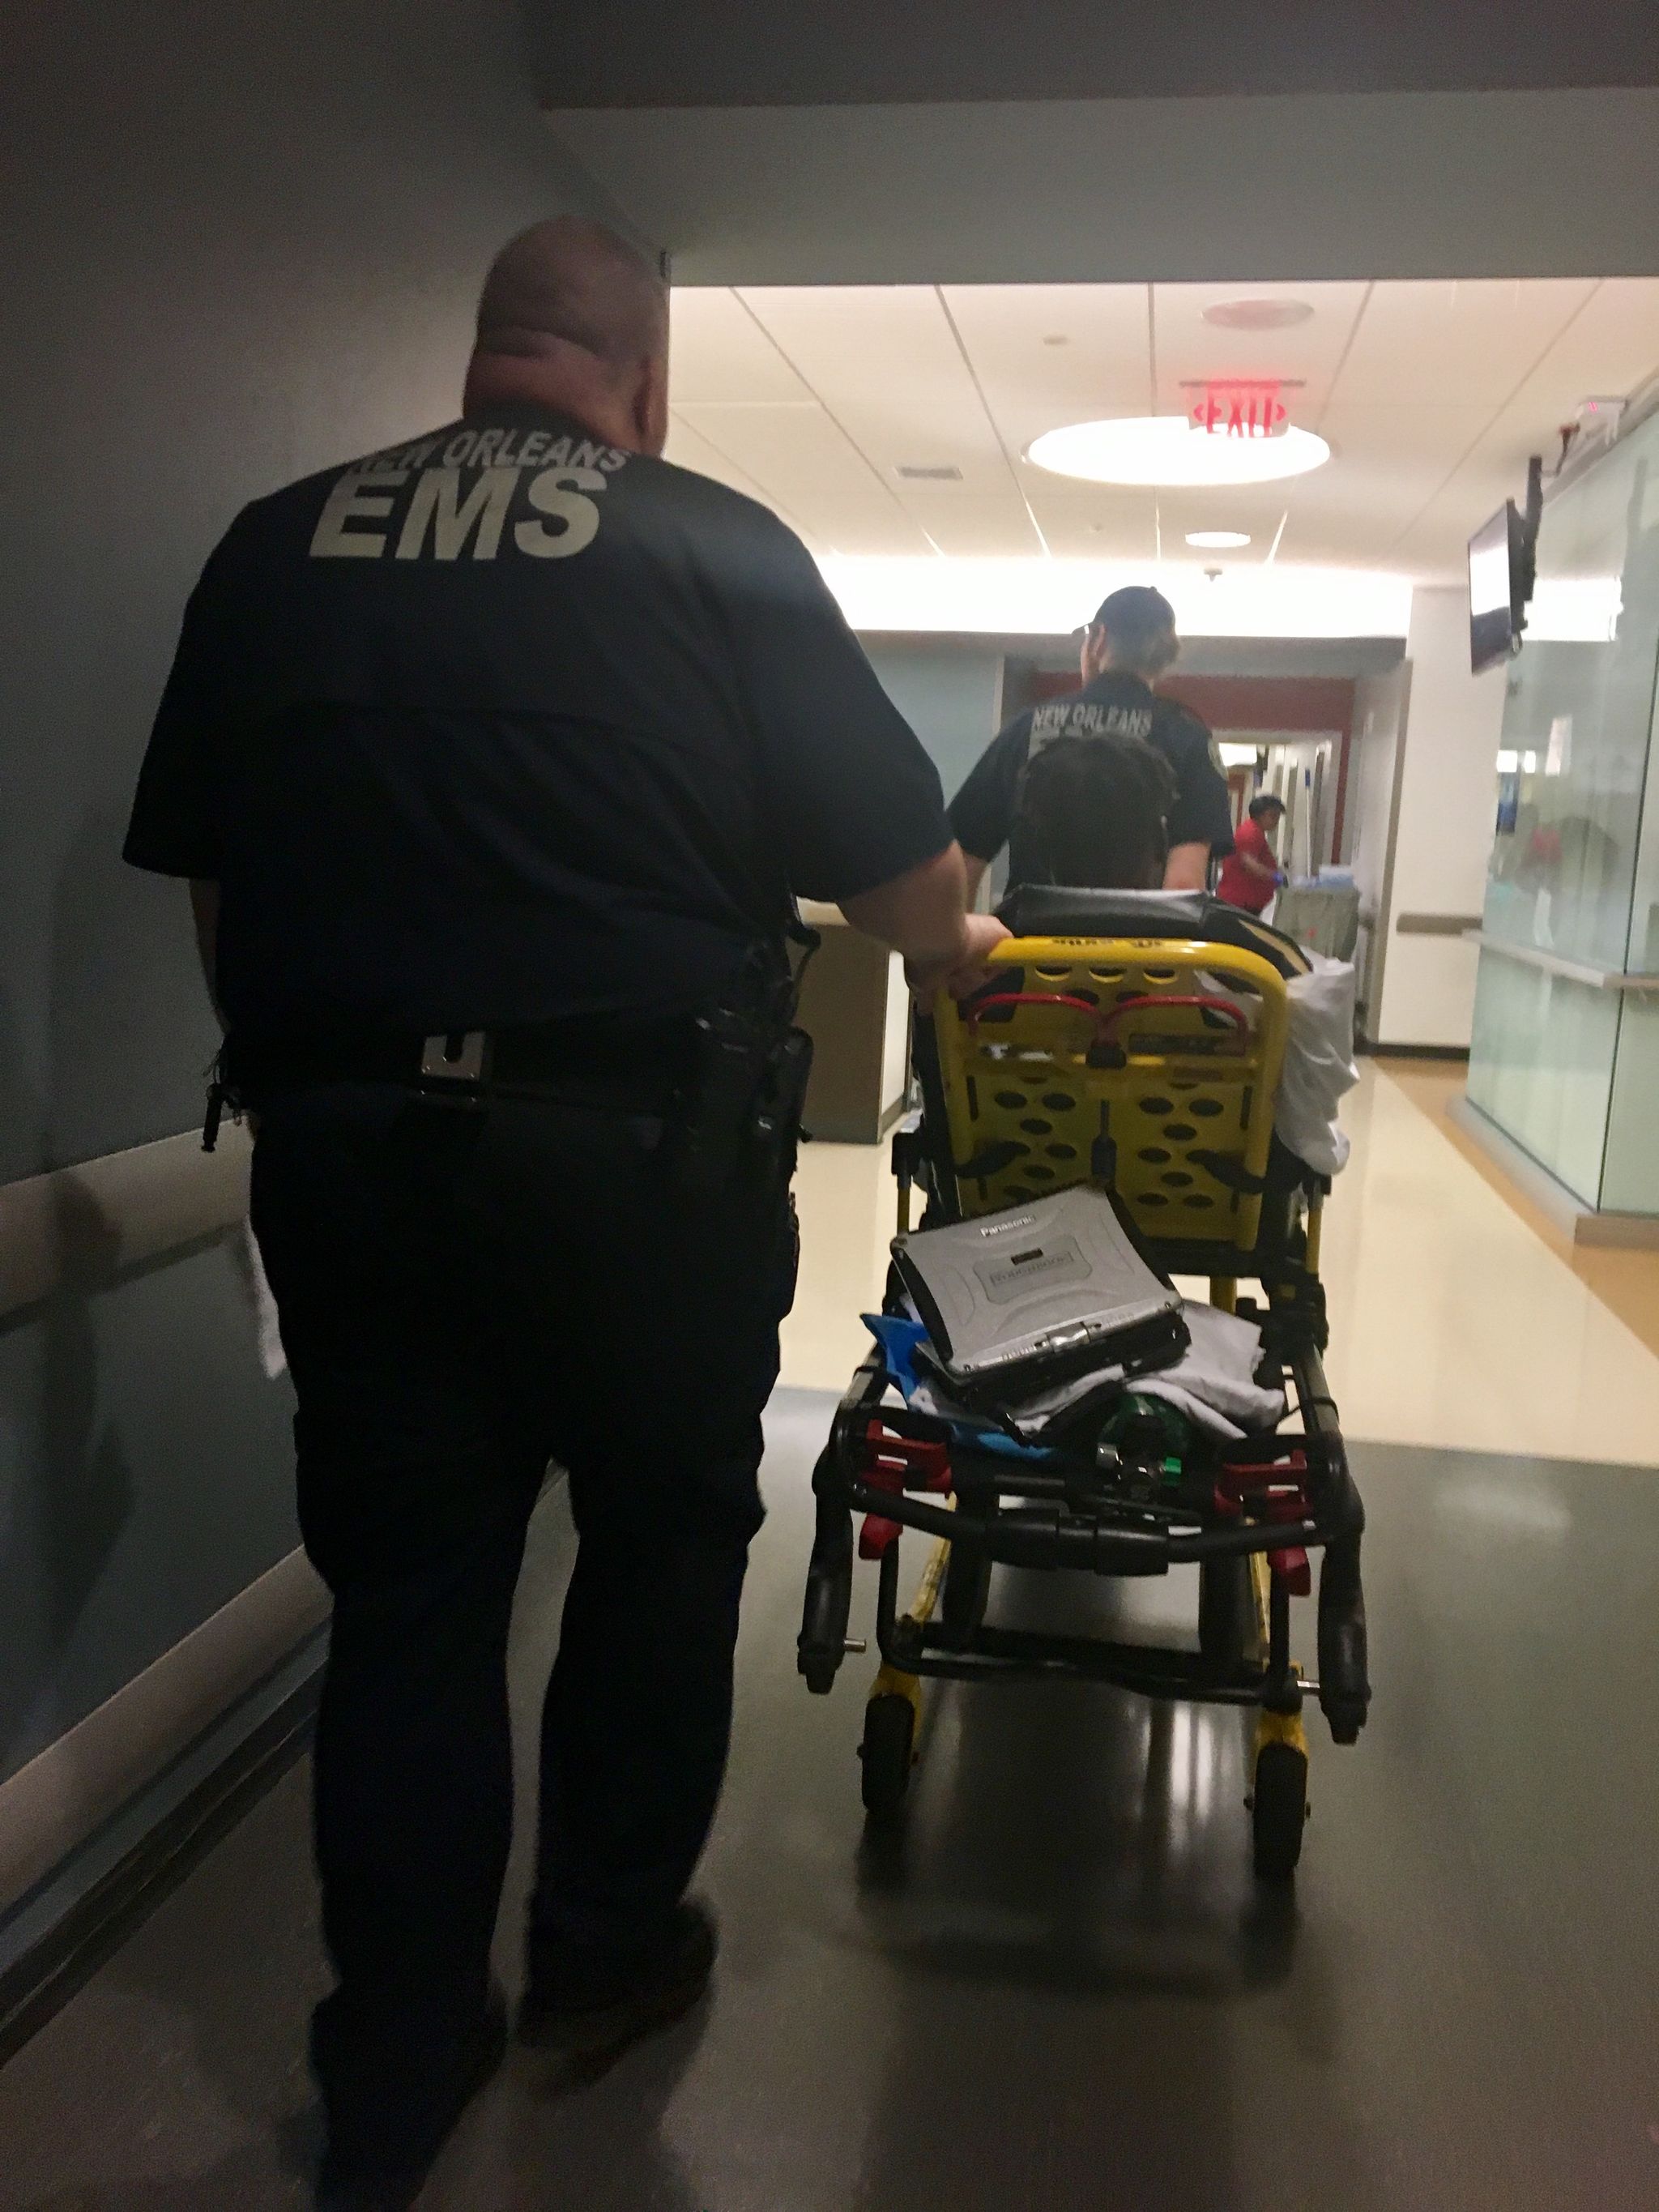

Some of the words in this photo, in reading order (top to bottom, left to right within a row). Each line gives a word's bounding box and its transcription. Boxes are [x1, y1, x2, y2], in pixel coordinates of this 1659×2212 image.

[1205, 387, 1280, 438] EXIT
[442, 428, 631, 472] ORLEANS
[309, 465, 608, 561] EMS
[1031, 703, 1071, 731] NEW
[1072, 702, 1154, 737] ORLEANS
[980, 1214, 1037, 1238] Panasonic
